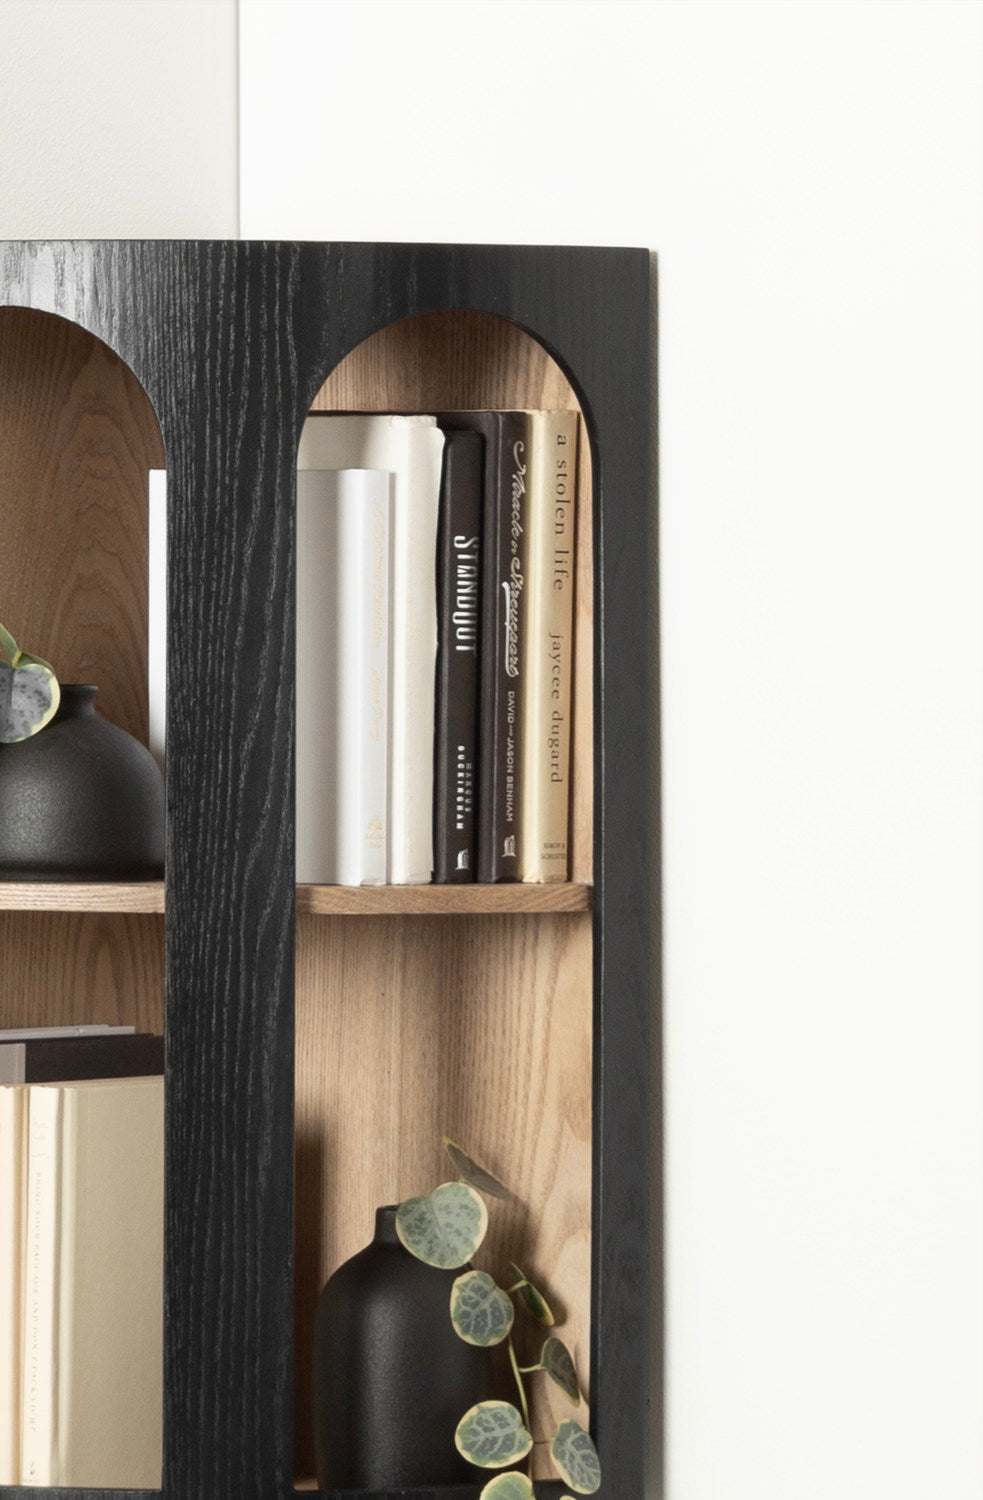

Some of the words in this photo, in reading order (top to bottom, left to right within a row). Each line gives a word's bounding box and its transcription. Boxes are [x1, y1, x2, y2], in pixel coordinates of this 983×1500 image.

[557, 435, 569, 446] a
[509, 441, 525, 537] Miracle
[554, 460, 570, 535] stolen
[453, 535, 478, 656] STANDOUT
[553, 549, 569, 591] life
[502, 557, 523, 677] Shreveport
[549, 633, 564, 699] jaycee
[506, 691, 515, 723] DAVID
[506, 737, 515, 772] JASON
[549, 711, 564, 784] dugard
[457, 745, 465, 829] BUCKINGHAM
[506, 775, 514, 821] BENHAM
